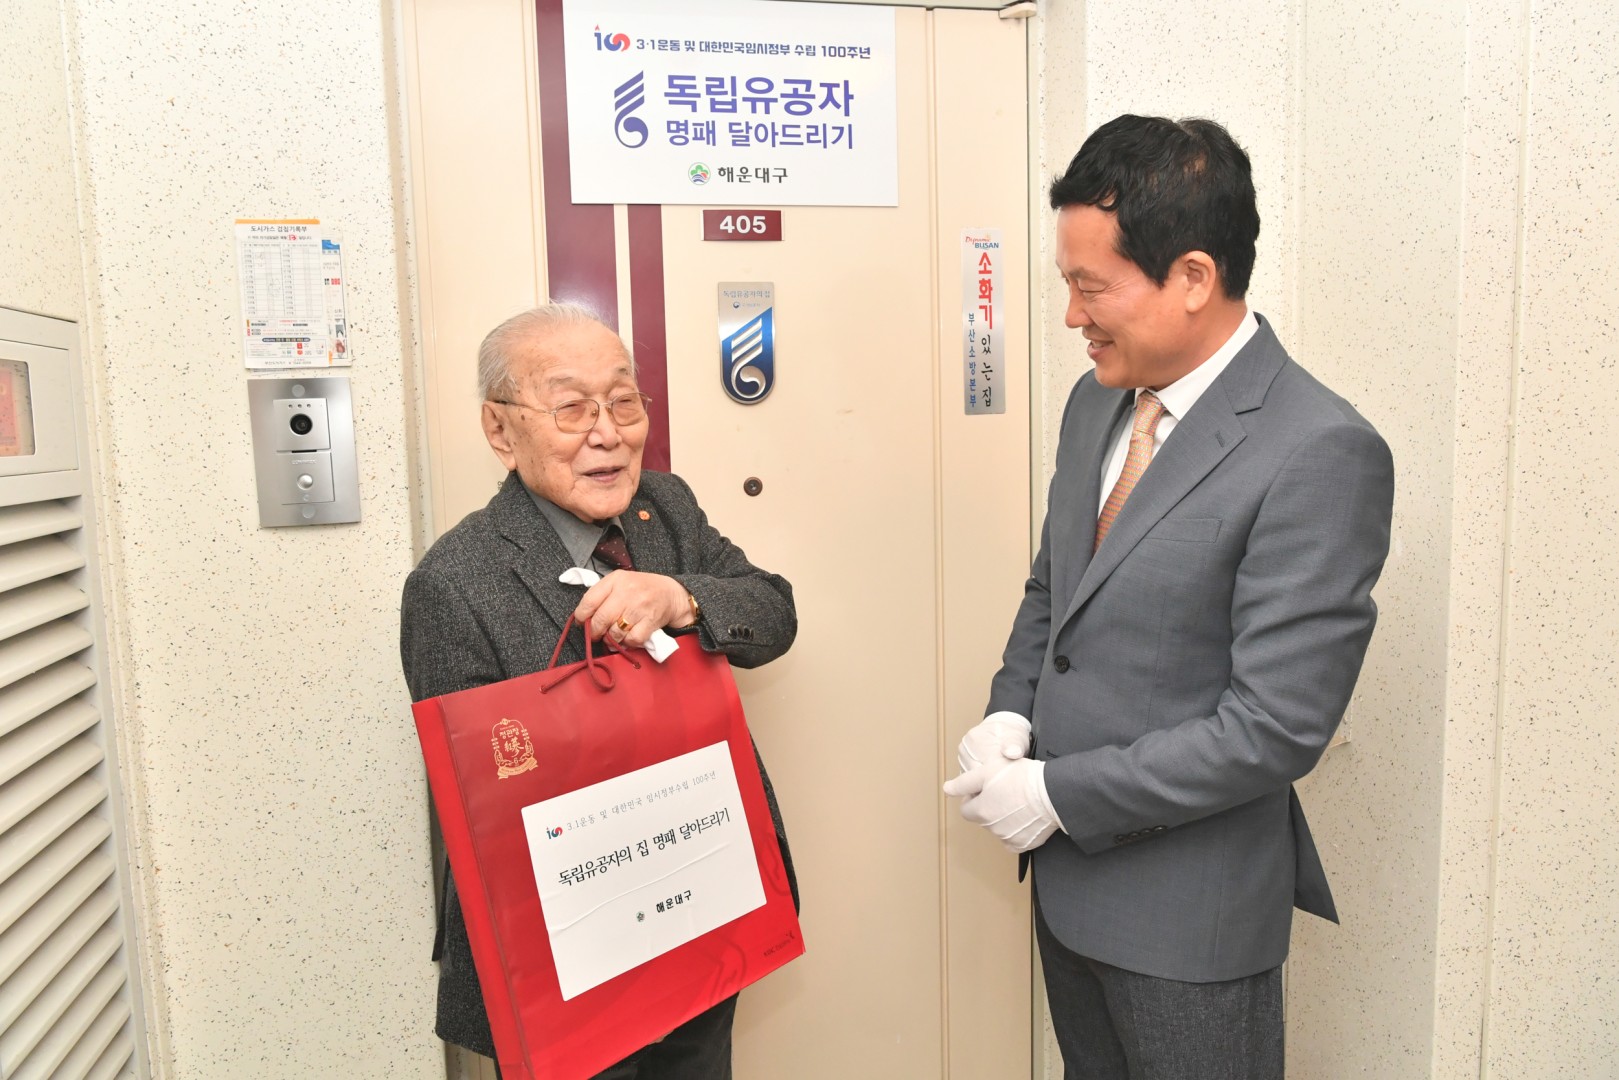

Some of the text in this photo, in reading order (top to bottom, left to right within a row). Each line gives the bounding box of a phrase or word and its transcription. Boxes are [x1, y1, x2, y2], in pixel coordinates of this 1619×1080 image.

[684, 40, 696, 52] 및
[699, 40, 791, 56] 대한민국임시정부
[794, 44, 816, 57] 수립
[821, 45, 871, 59] 100주년
[664, 74, 855, 117] 독립유공자
[666, 120, 854, 149] 명패 달아드리기
[717, 166, 789, 184] 해운대구
[719, 215, 767, 234] 405
[978, 252, 993, 407] 소화기 있는 집
[968, 313, 976, 408] 부산소방본부
[499, 727, 520, 739] 정관장
[566, 813, 596, 831] 3.1운동
[600, 810, 608, 821] 및
[612, 797, 643, 815] 대한민국
[692, 770, 717, 786] 100주년
[558, 807, 731, 887] 독립유공자의 집 명패 달아드리기
[656, 889, 692, 914] 해운대구
